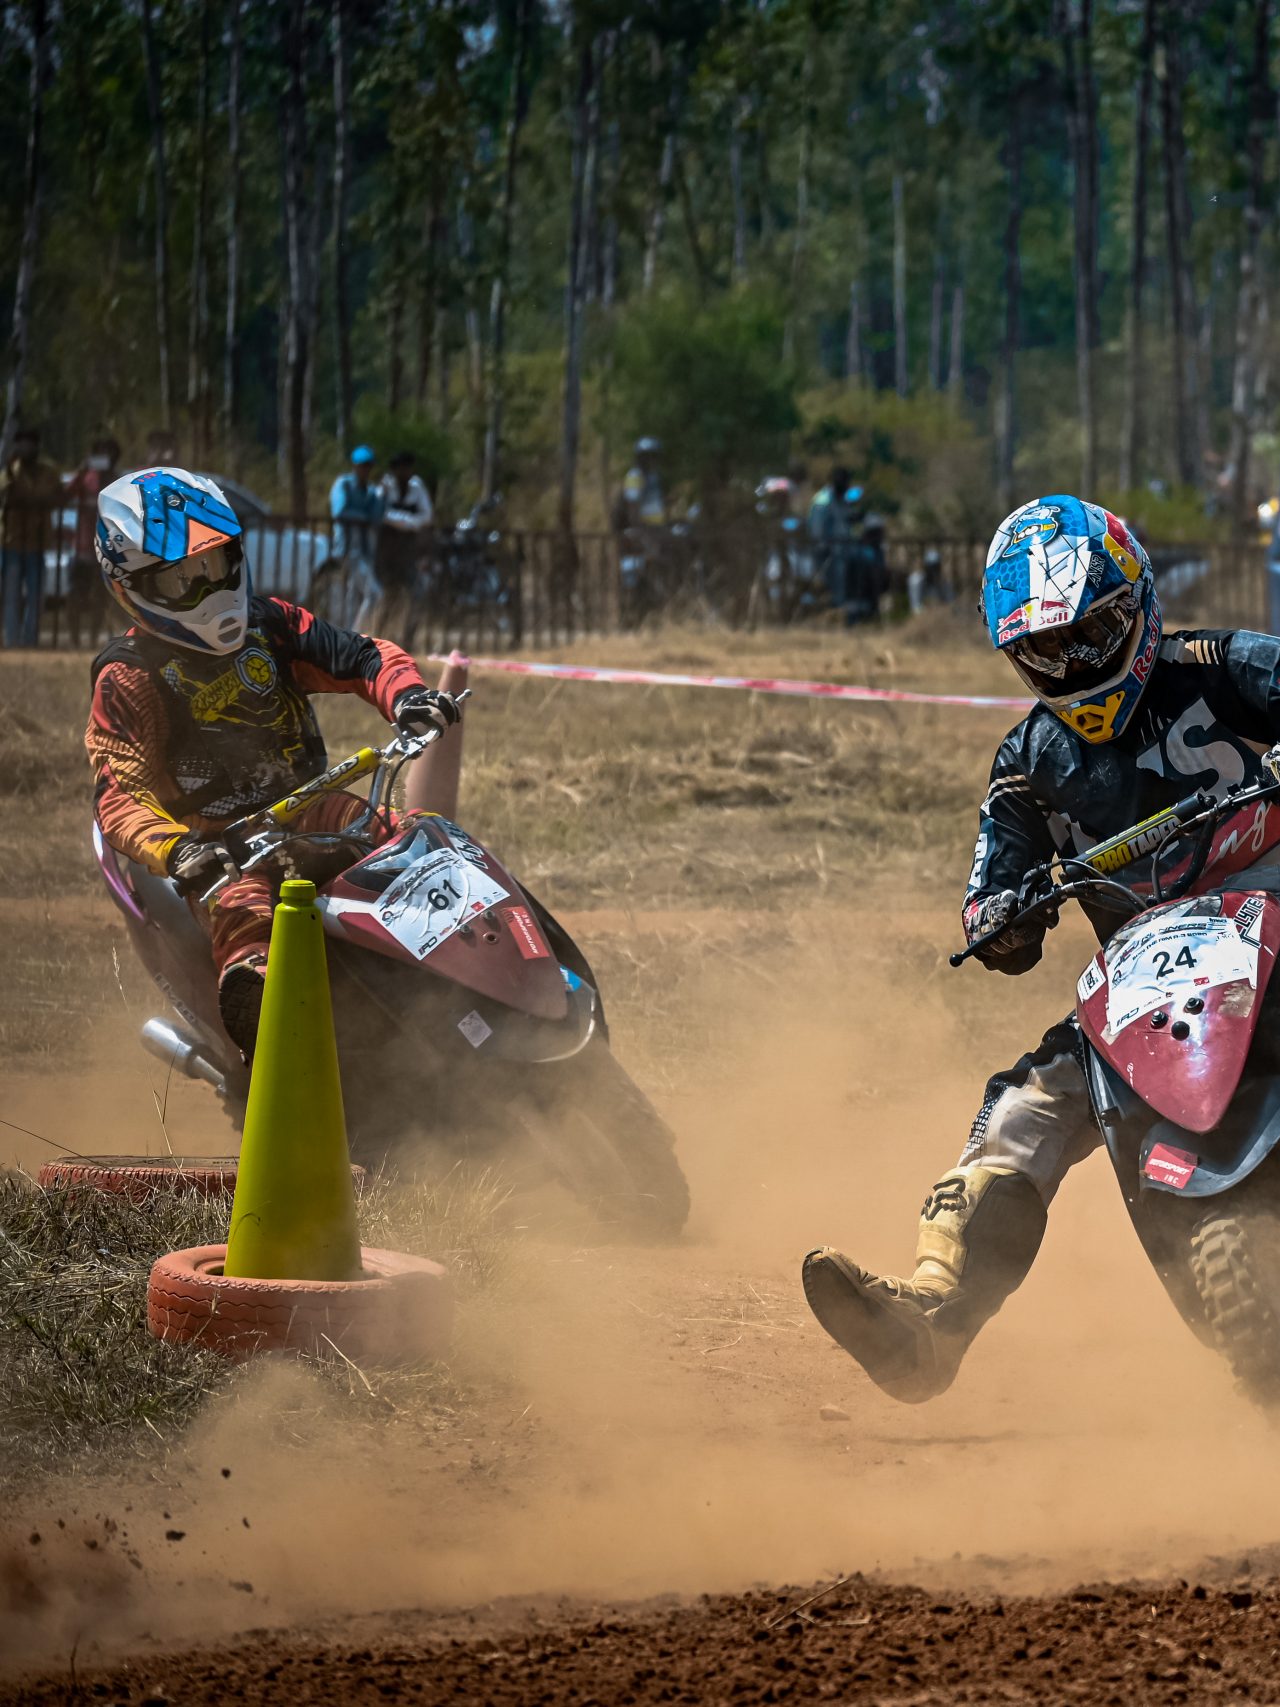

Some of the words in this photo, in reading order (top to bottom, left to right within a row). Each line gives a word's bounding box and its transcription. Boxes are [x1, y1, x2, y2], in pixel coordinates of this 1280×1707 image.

[998, 621, 1030, 644] Red
[1130, 619, 1160, 686] Red
[427, 879, 461, 911] 61
[1152, 945, 1197, 980] 24
